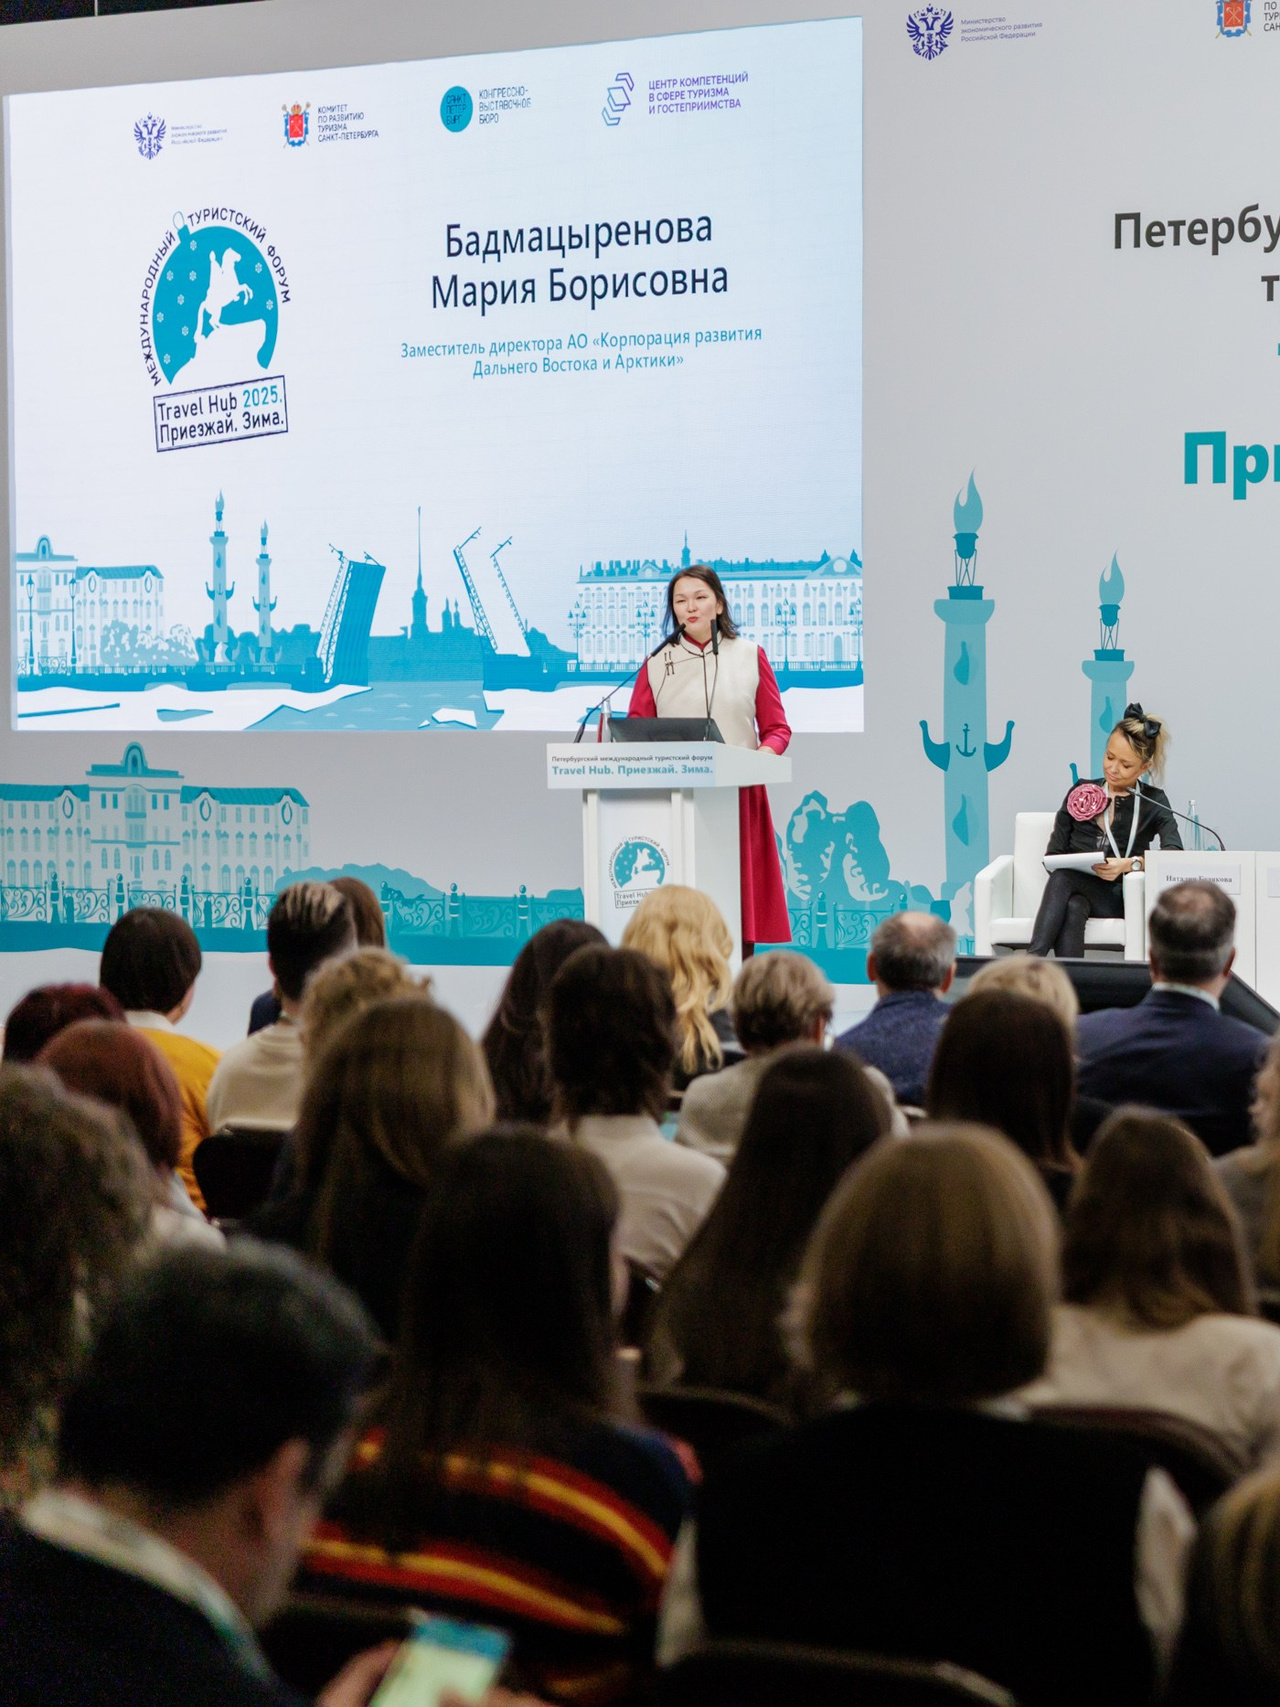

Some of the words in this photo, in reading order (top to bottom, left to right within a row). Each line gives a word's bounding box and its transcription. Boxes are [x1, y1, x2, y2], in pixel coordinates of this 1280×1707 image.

[1264, 1, 1277, 10] ПО
[961, 17, 1006, 25] Министерство
[961, 25, 1012, 33] экономического
[1013, 23, 1043, 31] развития
[961, 34, 998, 42] Российской
[1000, 32, 1036, 40] Федерации
[648, 79, 678, 91] ЦЕНТР
[680, 71, 749, 87] КОМПЕТЕНЦИЙ
[479, 86, 529, 99] КОНГРЕССНО-
[649, 93, 655, 102] В
[657, 91, 686, 101] СФЕРЕ
[687, 87, 730, 99] ТУРИЗМА
[317, 104, 348, 114] КОМИТЕТ
[479, 98, 532, 111] ВЫСТАВОЧНОЕ
[649, 105, 656, 114] И
[657, 98, 742, 114] ГОСТЕПРИИМСТВА
[318, 115, 328, 123] ПО
[329, 111, 365, 122] РАЗВИТИЮ
[479, 113, 499, 124] БЮРО
[318, 123, 347, 133] ТУРИЗМА
[318, 129, 379, 142] САНКТ-ПЕТЕРБУРГА
[446, 214, 713, 263] Бадмацыренова
[139, 231, 176, 386] МЕЖДУНАРОДНЫЙ
[187, 207, 266, 243] ТУРИСТСКИЙ
[267, 245, 291, 303] ФОРУМ
[432, 274, 537, 316] Мария
[549, 265, 729, 310] Борисовна
[401, 342, 486, 358] Заместитель
[489, 336, 563, 357] директора
[567, 334, 588, 350] АО
[593, 331, 690, 352] «Корпорация
[695, 327, 763, 347] развития
[473, 360, 538, 379] Дальнего
[542, 356, 598, 374] Востока
[602, 357, 611, 370] и
[615, 354, 685, 373] Арктики»
[157, 396, 203, 421] Travel
[208, 392, 238, 412] Hub
[242, 385, 282, 408] 2025.
[159, 413, 238, 446] Приезжай.
[242, 411, 284, 433] Зима.
[691, 754, 713, 762] форум
[552, 766, 586, 775] Travel
[588, 765, 614, 775] Hub.
[617, 764, 678, 776] Приезжай.
[681, 764, 713, 774] Зима.
